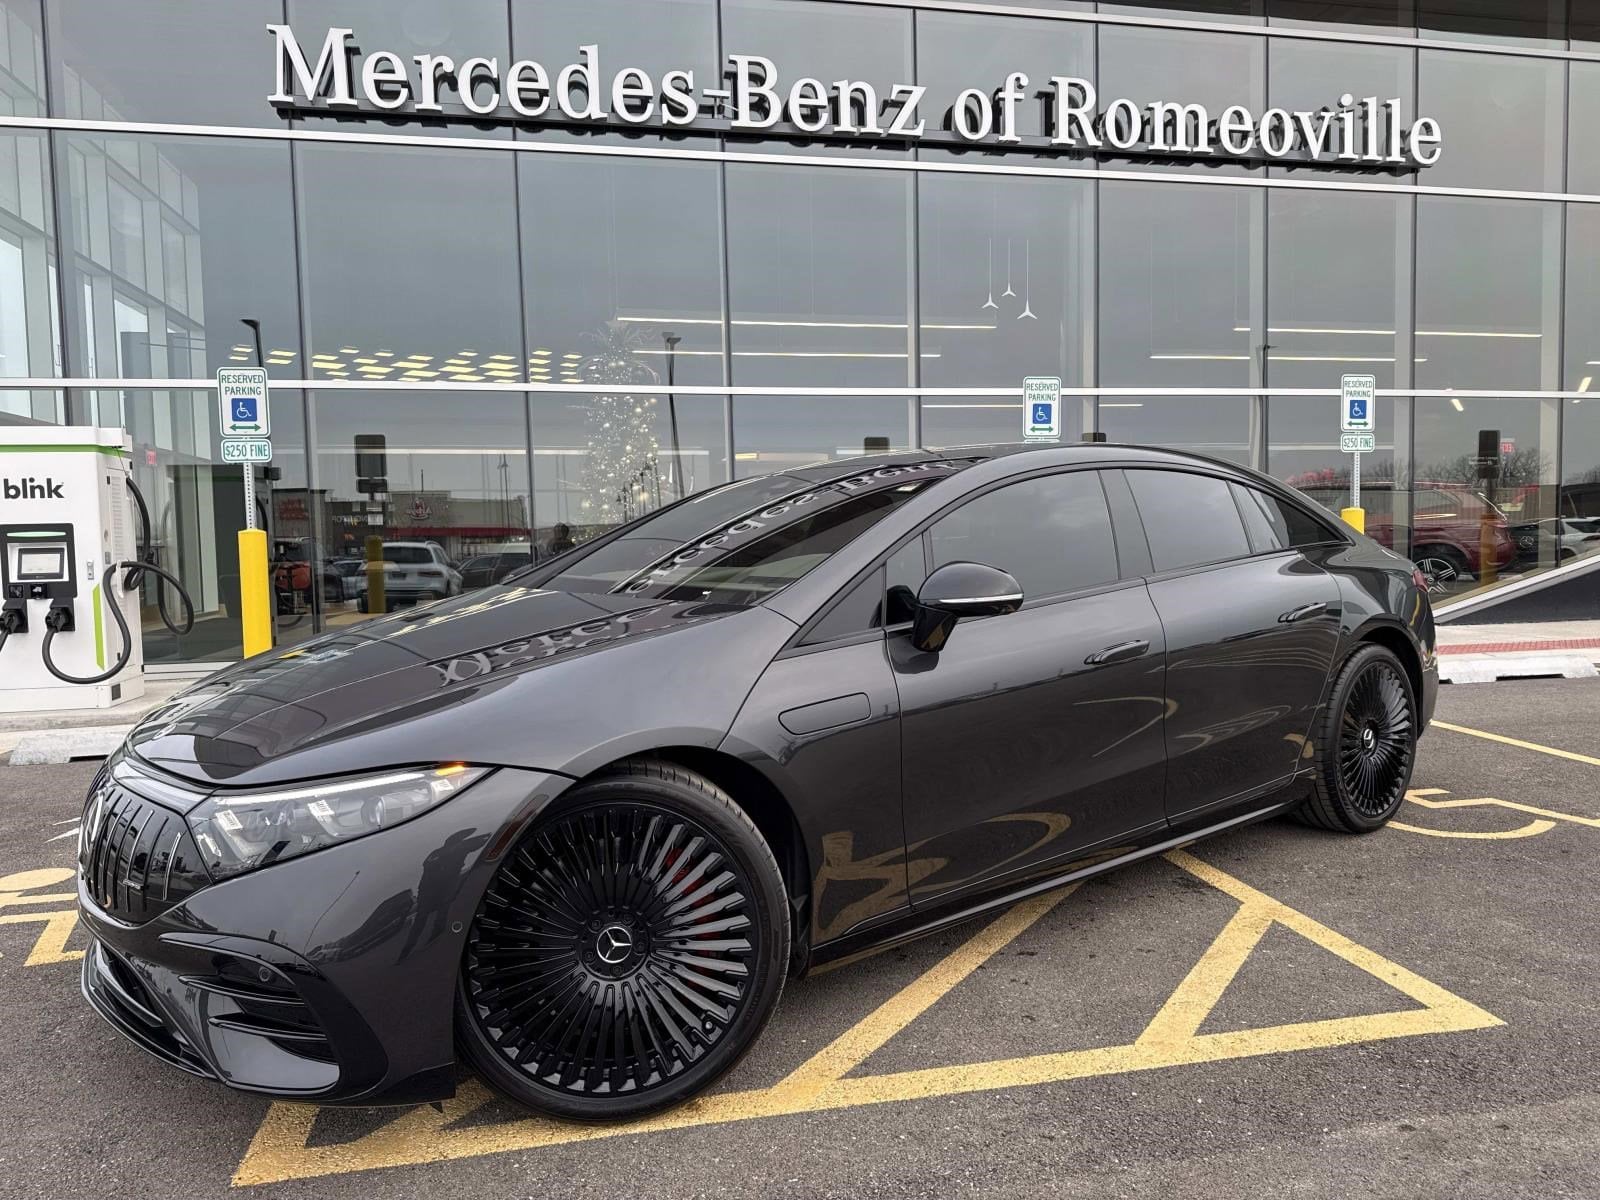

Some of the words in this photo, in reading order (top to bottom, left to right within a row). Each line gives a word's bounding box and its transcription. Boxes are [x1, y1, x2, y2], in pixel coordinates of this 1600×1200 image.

[266, 23, 928, 137] Mercedes-Benz
[953, 72, 1029, 144] of
[1050, 76, 1443, 166] Romeoville
[221, 374, 264, 384] RESERVED
[1026, 383, 1059, 391] RESERVED
[1344, 380, 1373, 388] RESERVED
[224, 386, 262, 395] PARKING
[1346, 389, 1371, 397] PARKING
[1028, 393, 1057, 401] PARKING
[1360, 437, 1373, 448] FINE
[225, 445, 247, 457] $250
[250, 444, 268, 457] FINE
[3, 477, 64, 499] blink
